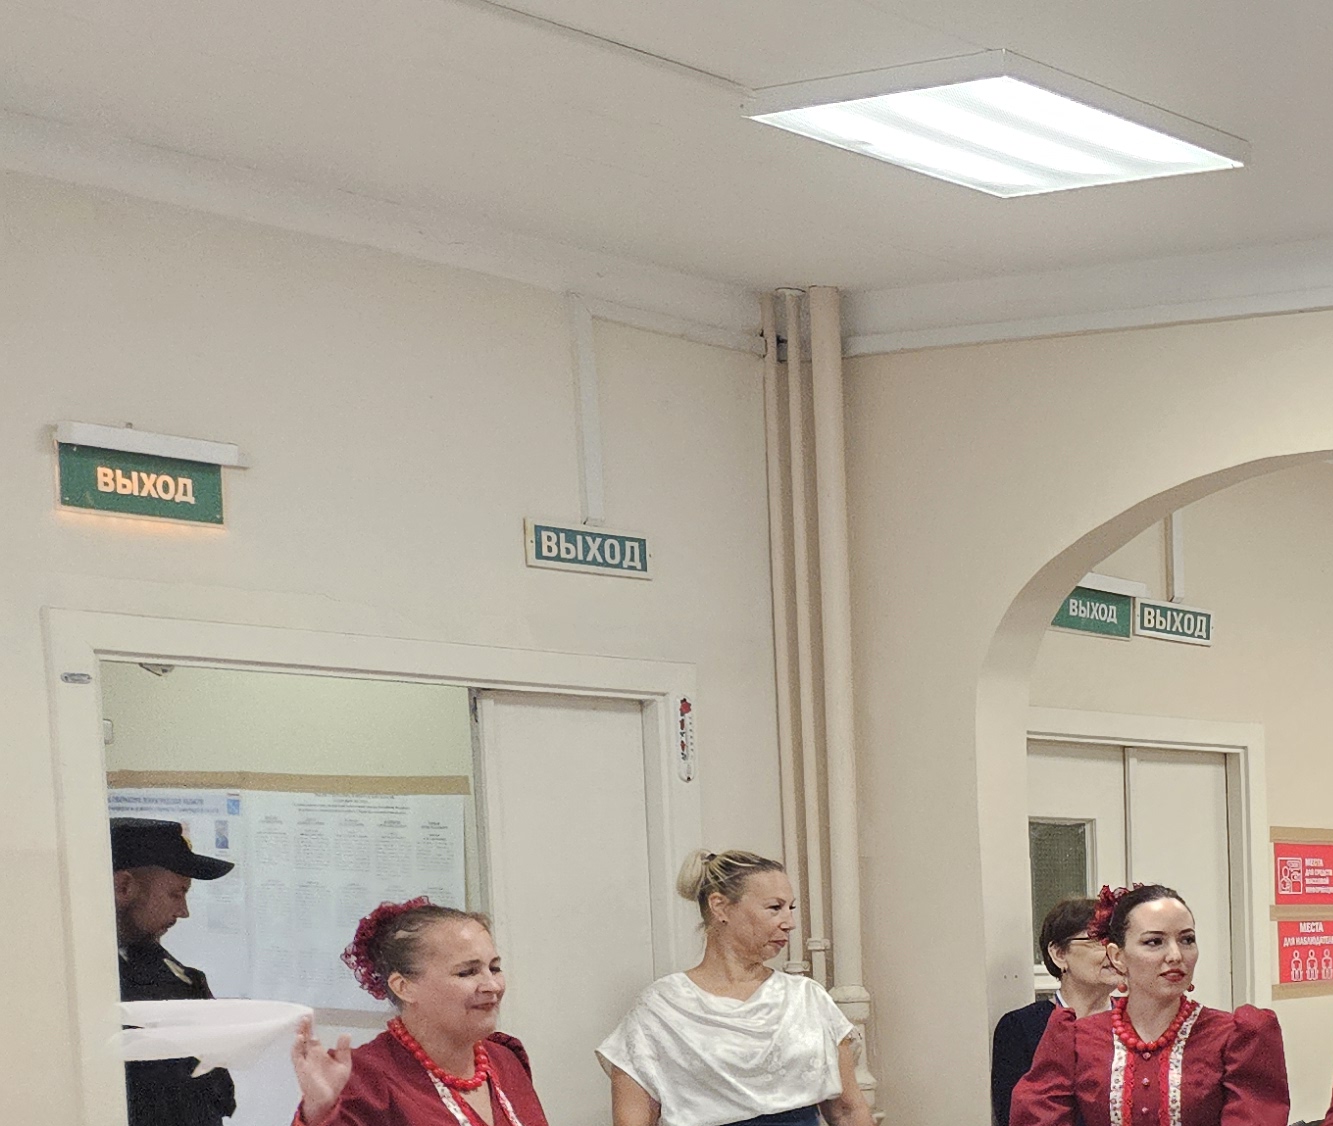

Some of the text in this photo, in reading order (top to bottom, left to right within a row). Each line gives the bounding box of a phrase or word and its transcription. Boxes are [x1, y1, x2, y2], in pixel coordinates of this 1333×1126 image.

[96, 466, 195, 504] ВЫХОД
[540, 530, 642, 570] ВЫХОД
[1069, 598, 1118, 624] ВЫХОД
[1143, 607, 1208, 638] ВЫХОД
